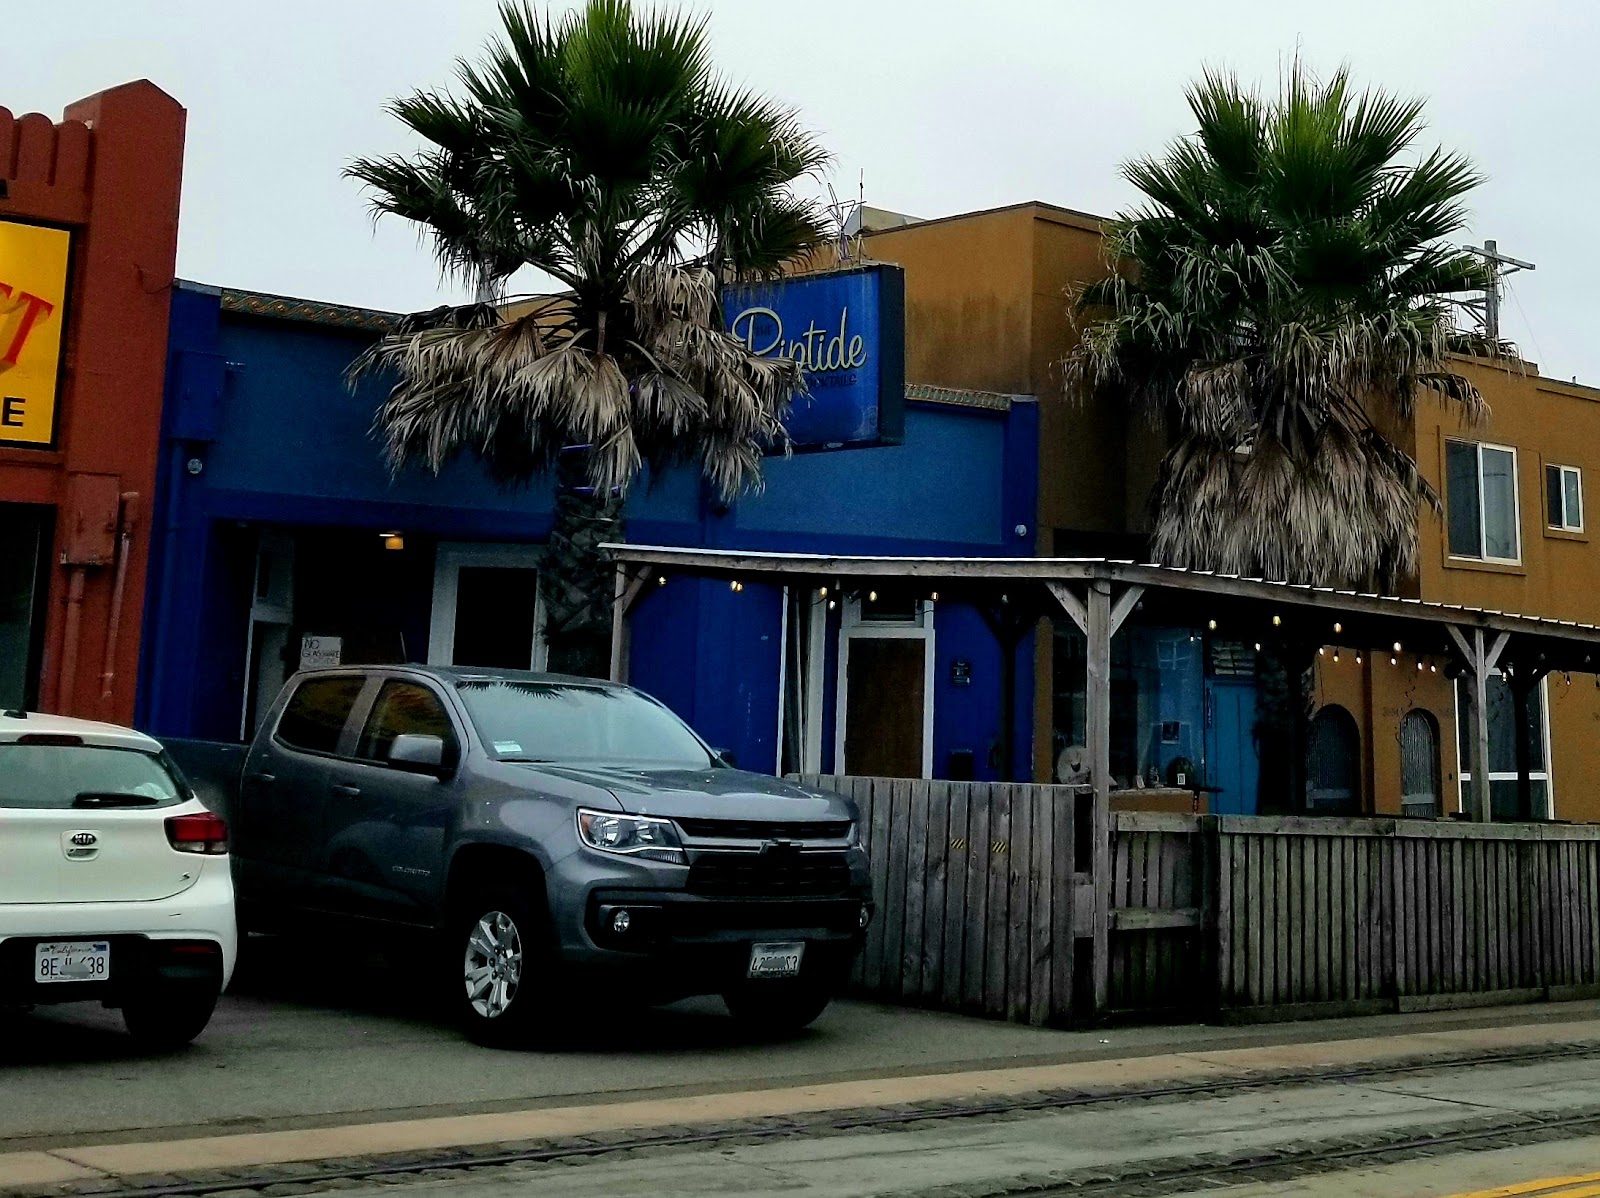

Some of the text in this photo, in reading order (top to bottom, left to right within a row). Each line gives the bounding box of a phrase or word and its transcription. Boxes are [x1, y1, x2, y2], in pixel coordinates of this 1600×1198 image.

[0, 282, 54, 365] T
[304, 638, 320, 650] NO
[72, 832, 96, 846] KIA
